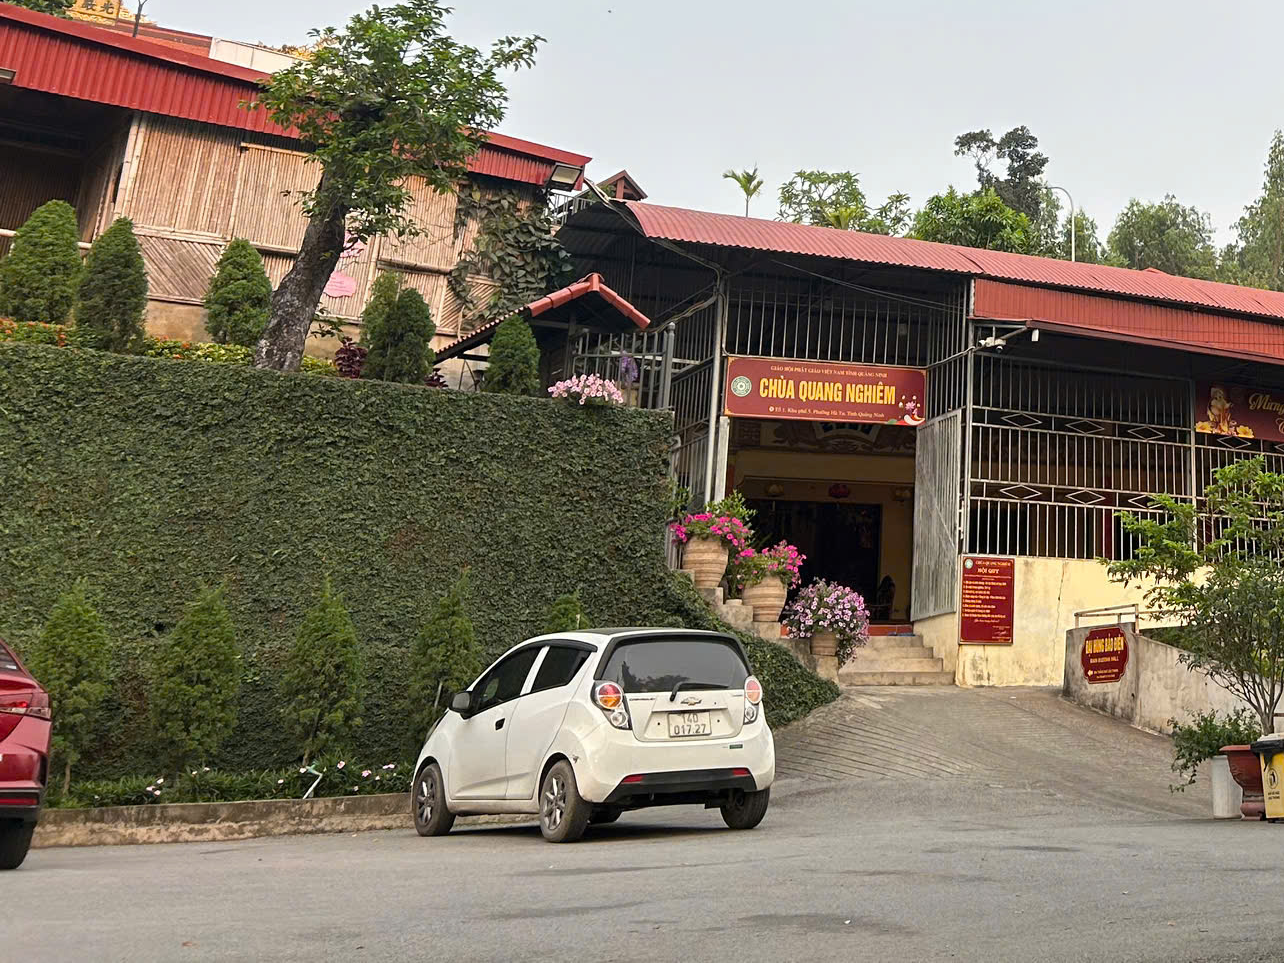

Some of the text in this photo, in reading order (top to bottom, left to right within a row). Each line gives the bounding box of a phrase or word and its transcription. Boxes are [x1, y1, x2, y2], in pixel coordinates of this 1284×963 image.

[759, 375, 896, 405] CHÙA QUANG NGHIÊM
[673, 724, 707, 735] 017.27
